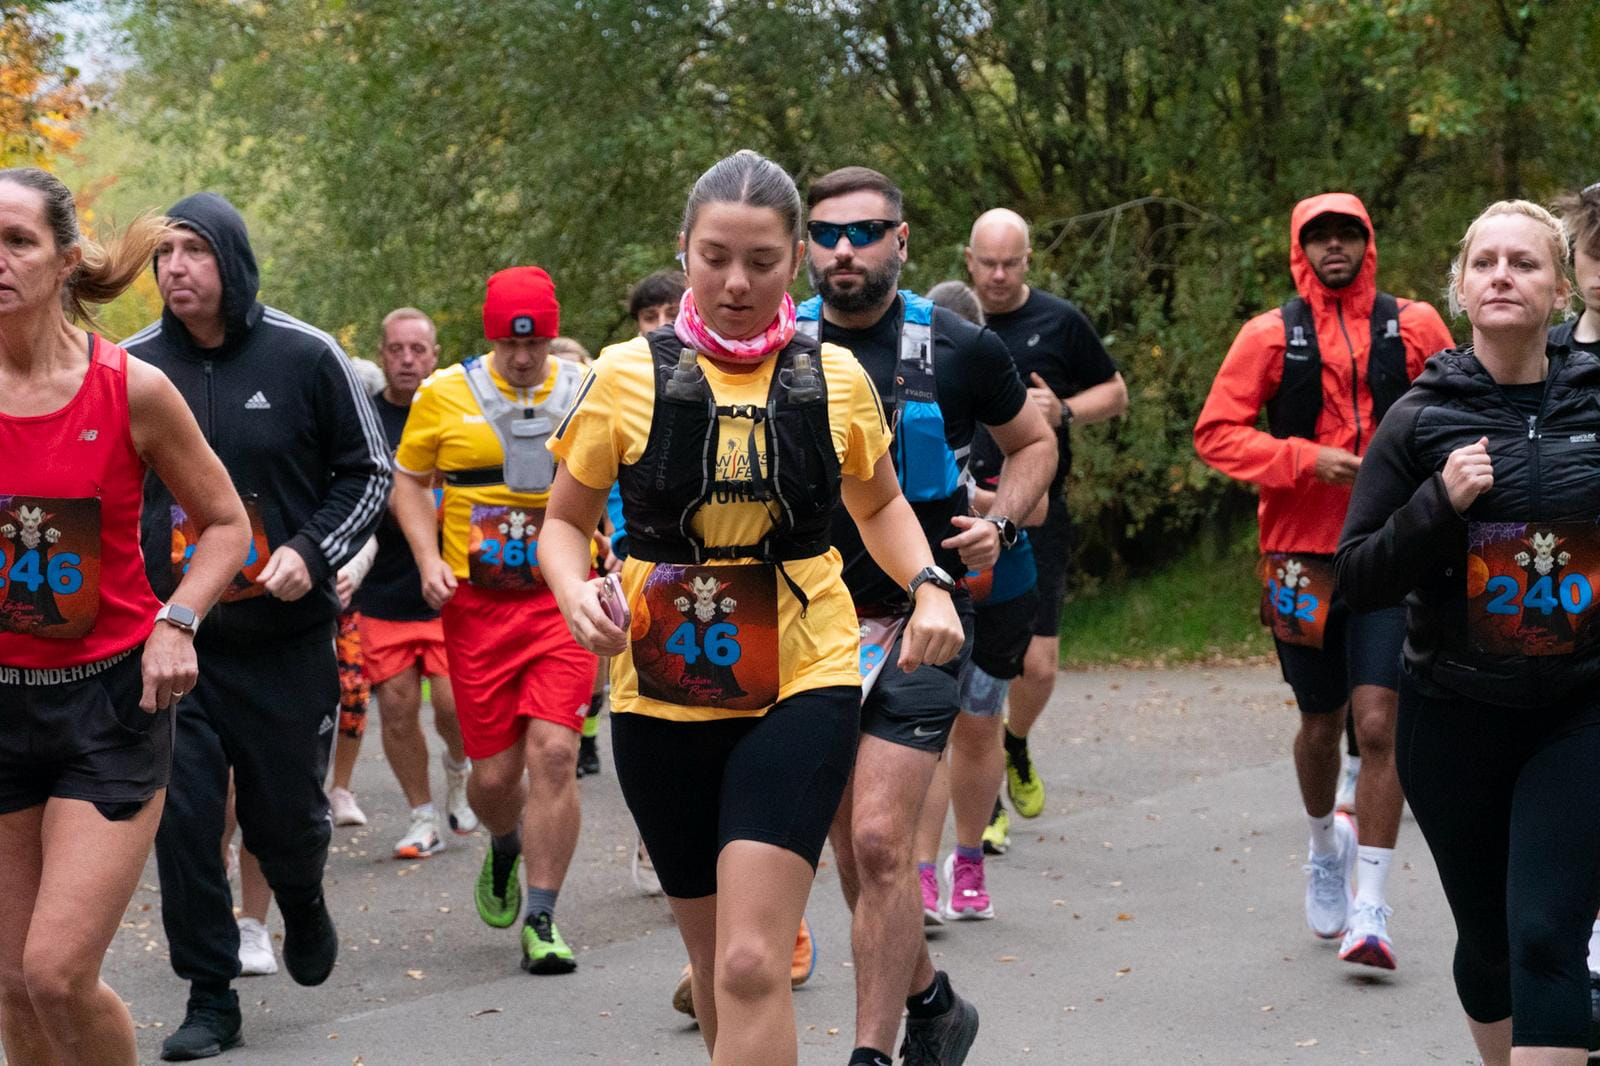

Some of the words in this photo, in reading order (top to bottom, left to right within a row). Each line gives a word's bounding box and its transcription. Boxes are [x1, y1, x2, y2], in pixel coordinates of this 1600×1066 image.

[905, 388, 933, 398] EVADICT
[0, 548, 83, 595] 46
[1486, 572, 1593, 615] 240
[665, 621, 741, 666] 46
